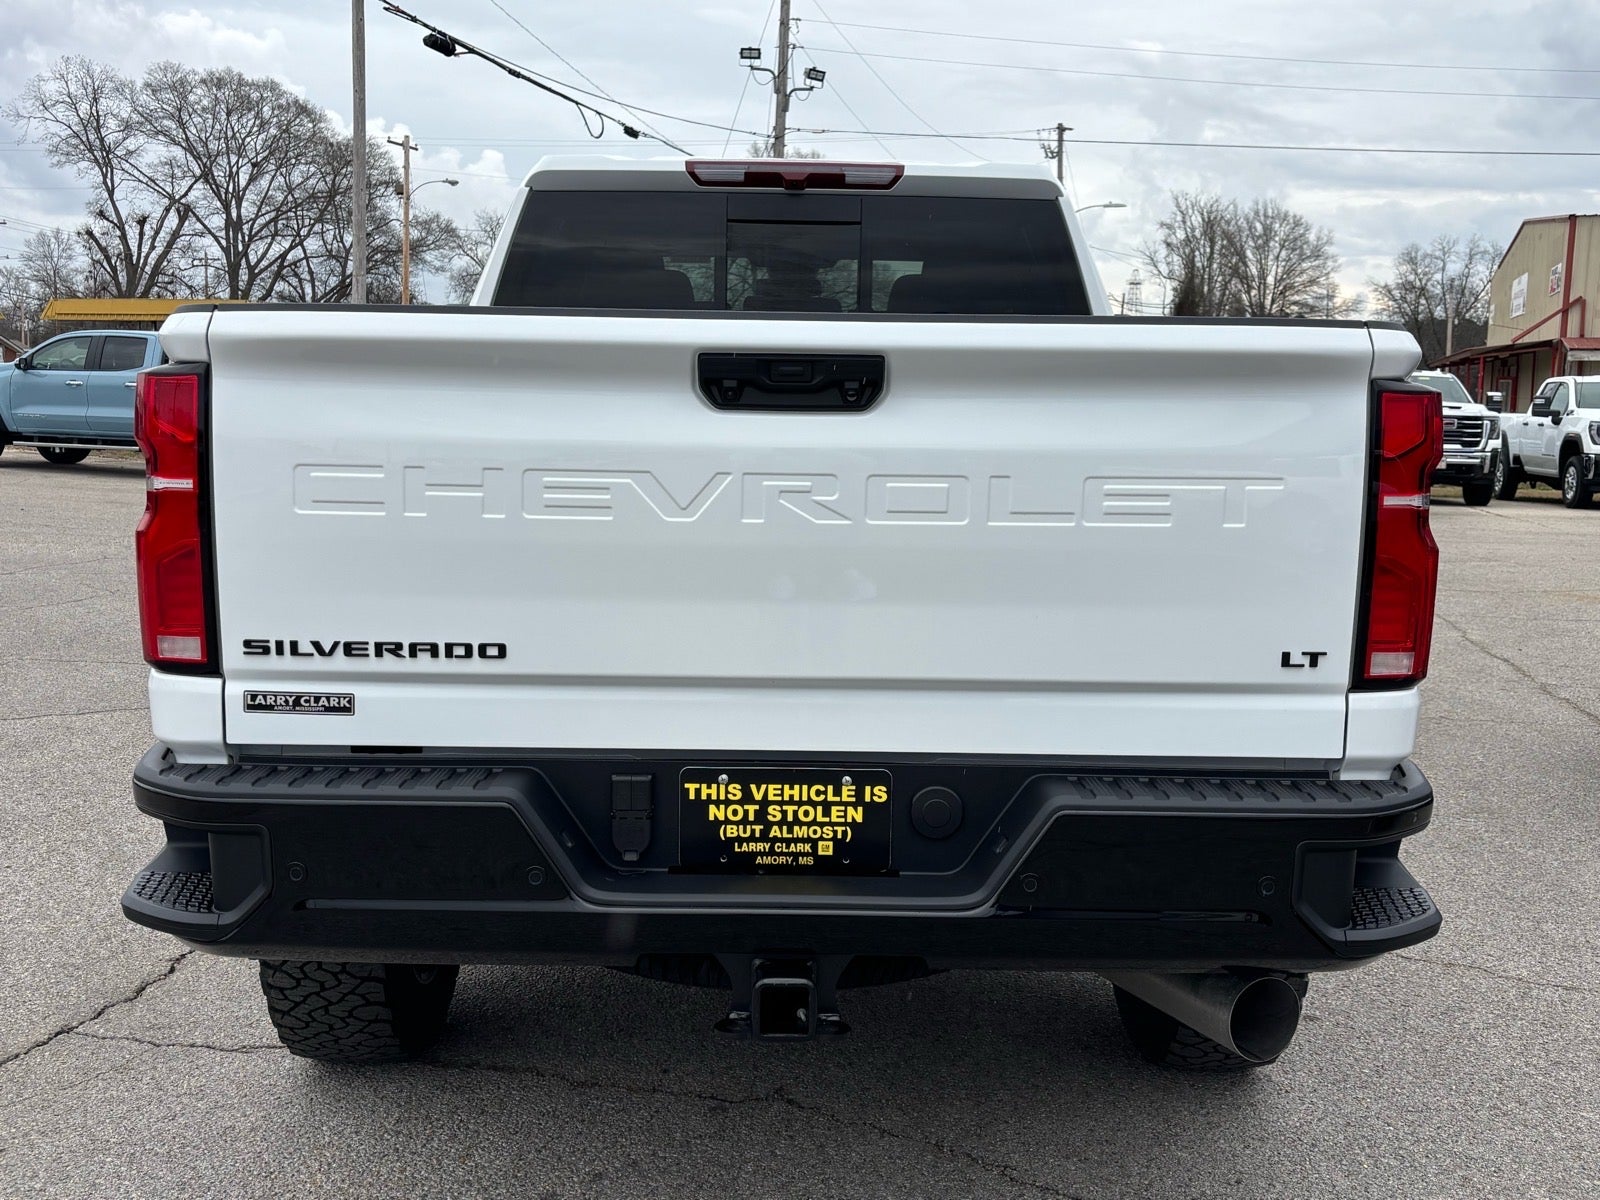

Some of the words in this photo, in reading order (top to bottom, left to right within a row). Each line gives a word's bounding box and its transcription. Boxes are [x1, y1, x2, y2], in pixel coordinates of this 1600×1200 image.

[293, 464, 1284, 527] CHEVROLET
[242, 639, 507, 659] SILVERADO
[1281, 651, 1328, 668] LT
[247, 694, 296, 705] LARRY
[300, 696, 350, 707] CLARK
[684, 783, 742, 800] THIS
[750, 784, 856, 802] VEHICLE
[864, 785, 888, 802] IS
[708, 804, 759, 821] NOT
[766, 805, 863, 823] STOLEN
[719, 824, 764, 840] (BUT
[768, 826, 852, 842] ALMOST)
[734, 842, 770, 852] LARRY
[774, 843, 812, 853] CLARK
[755, 855, 796, 866] AMORY,
[798, 856, 814, 865] MS
